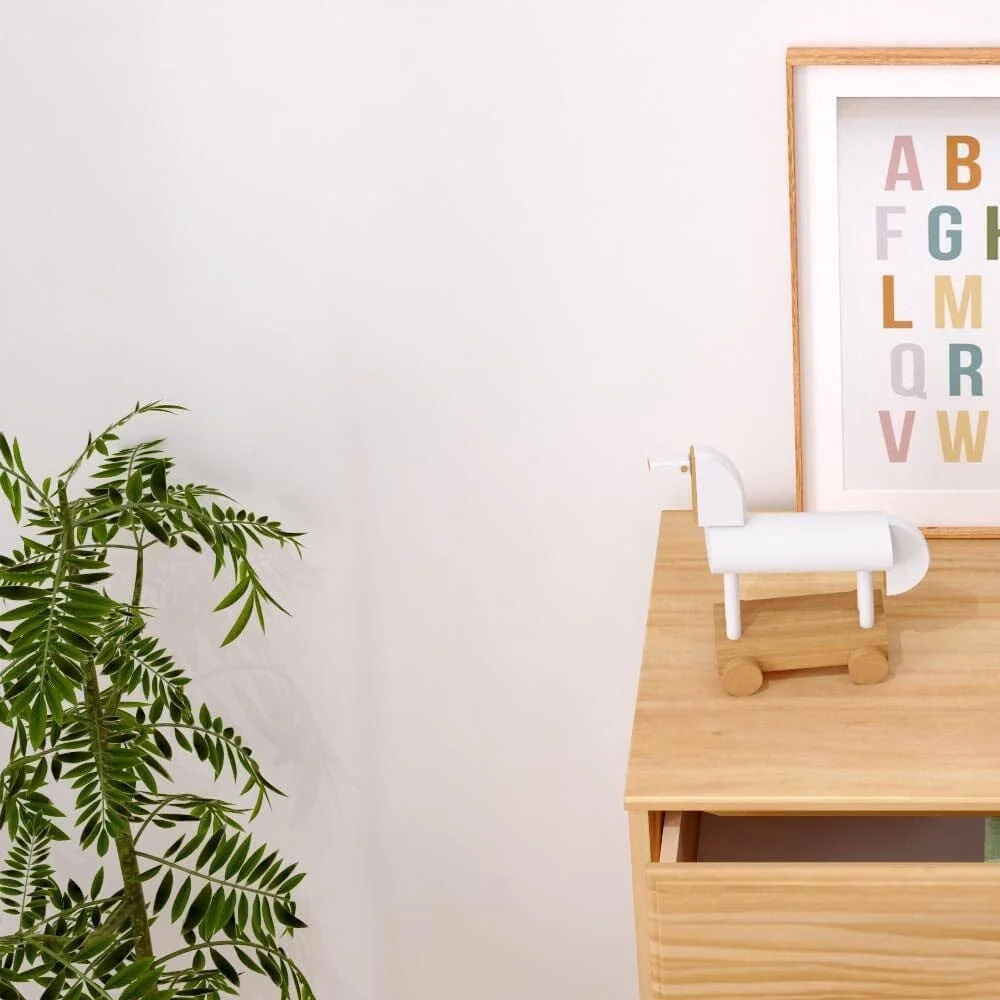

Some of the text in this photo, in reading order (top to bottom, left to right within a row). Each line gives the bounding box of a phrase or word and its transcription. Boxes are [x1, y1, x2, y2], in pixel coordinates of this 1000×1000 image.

[884, 134, 924, 191] A
[945, 134, 982, 191] B
[875, 205, 906, 261] F
[928, 204, 963, 261] G
[882, 274, 914, 329] L
[934, 274, 983, 329] M
[890, 343, 928, 399] Q
[948, 343, 984, 397] R
[878, 410, 917, 463] V
[936, 410, 990, 463] W
